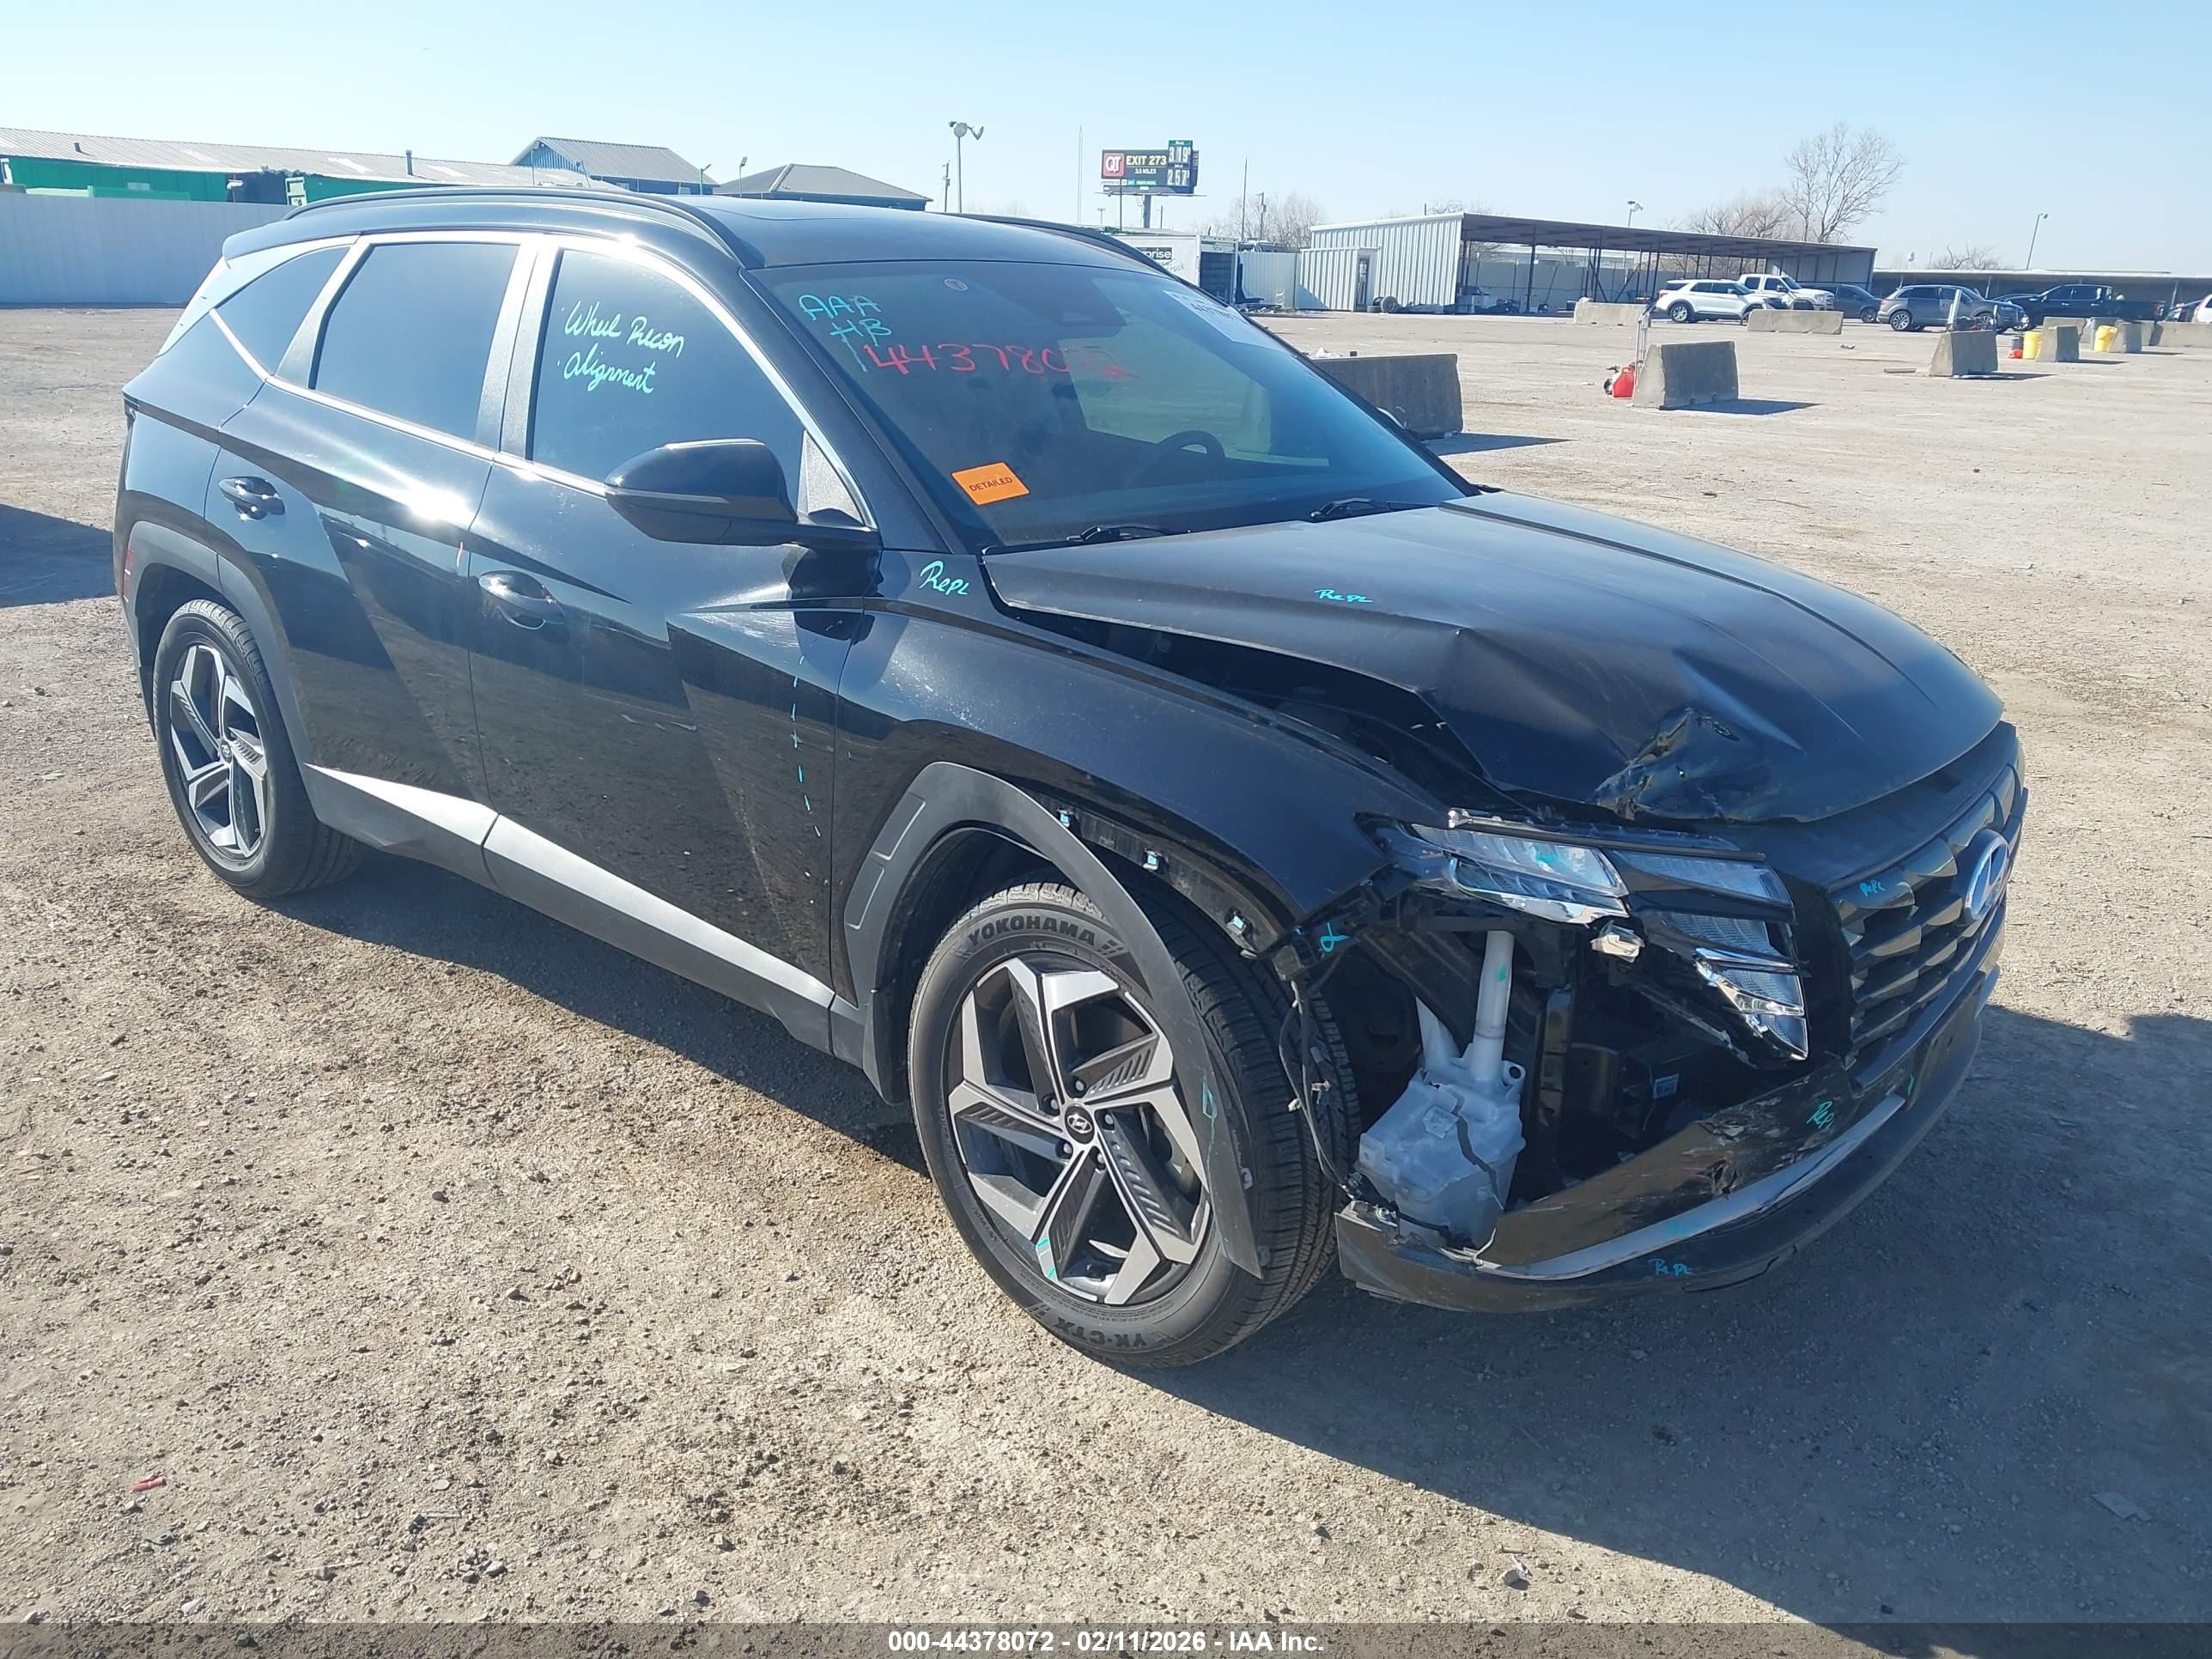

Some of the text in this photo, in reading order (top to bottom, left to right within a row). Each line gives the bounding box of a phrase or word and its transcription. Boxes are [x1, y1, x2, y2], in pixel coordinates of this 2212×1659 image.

[1106, 156, 1121, 173] QT
[1126, 155, 1167, 166] EXIT 273
[799, 295, 882, 321] AAA
[564, 301, 684, 358] Wheel Recon
[969, 477, 1013, 492] DETAILED
[968, 915, 1095, 946] YOKOHAMA
